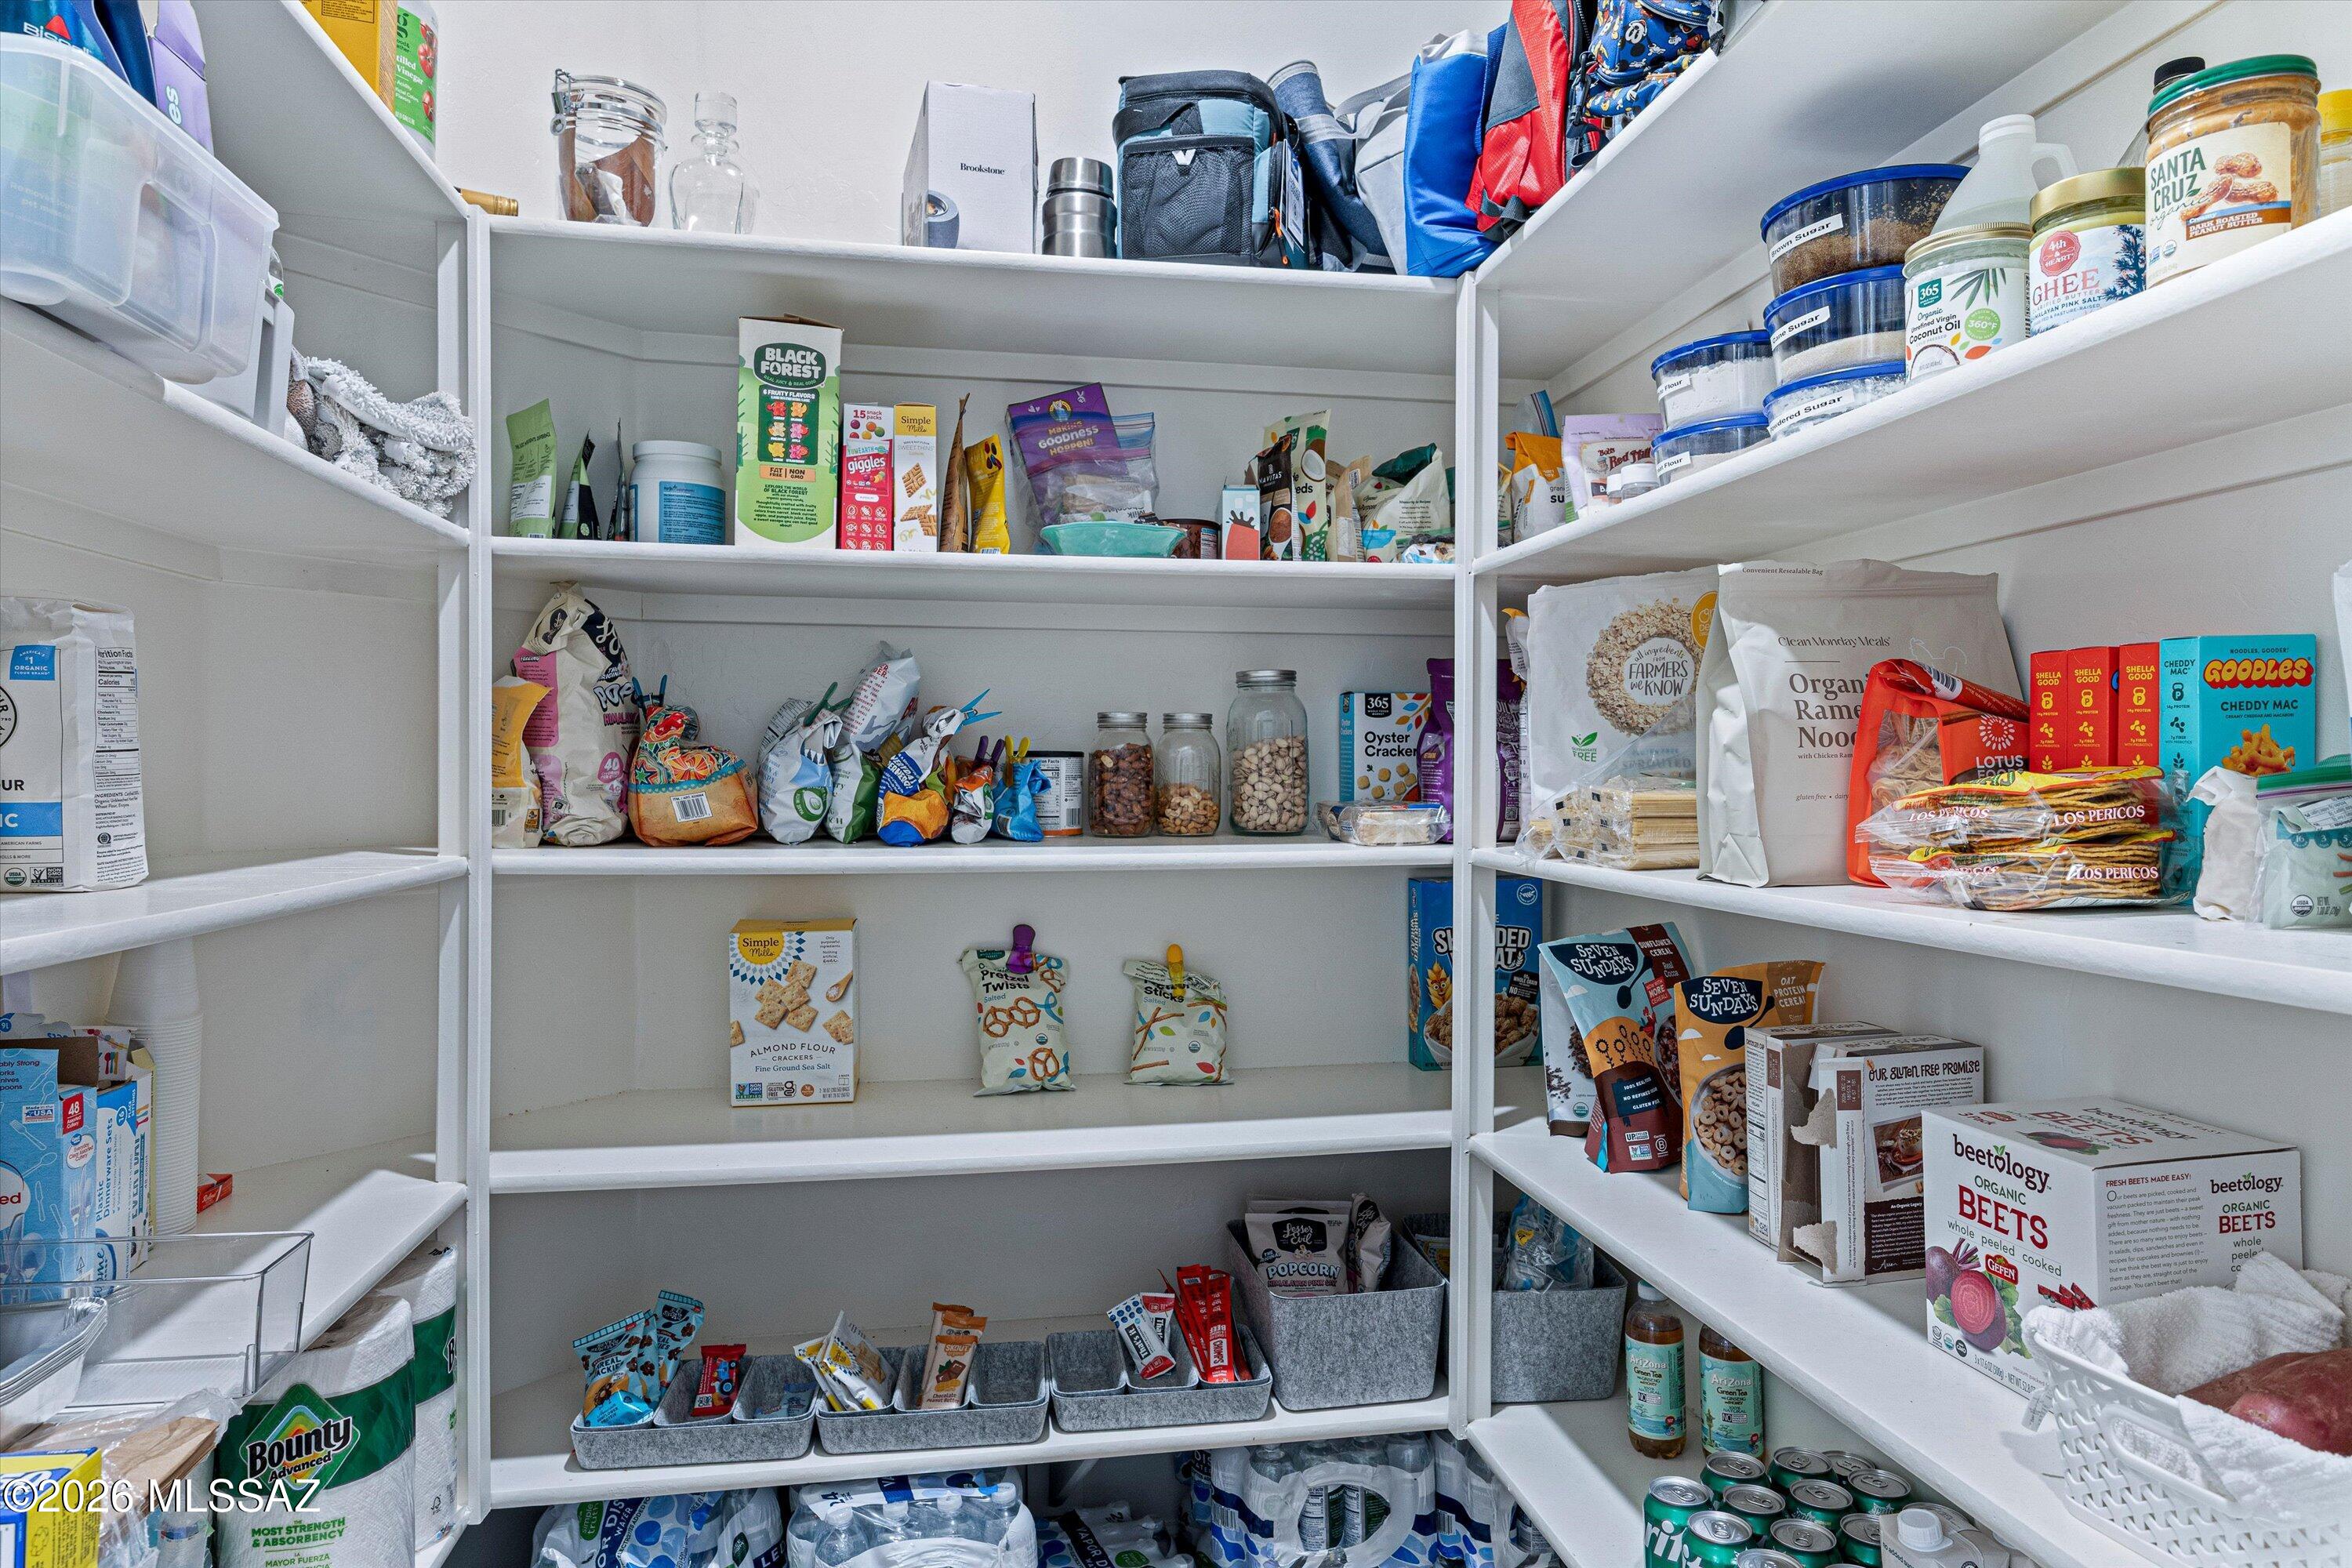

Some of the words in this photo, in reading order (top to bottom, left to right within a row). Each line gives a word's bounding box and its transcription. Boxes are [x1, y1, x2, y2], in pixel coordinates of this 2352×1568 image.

[397, 65, 423, 85] Vinegar
[960, 163, 1005, 175] Brookstone
[2151, 147, 2207, 191] SANTA
[2154, 173, 2199, 212] CRUZ
[2150, 197, 2207, 230] organic
[2189, 221, 2212, 232] DARK
[2216, 212, 2259, 225] ROASTED
[2189, 226, 2225, 238] PEANUT
[2227, 218, 2263, 230] BUTTER
[1771, 239, 1793, 258] Brown
[1795, 221, 1831, 241] Sugar
[2049, 239, 2067, 251] 4th
[2045, 255, 2071, 267] HEART
[1919, 284, 1939, 300] 365
[2032, 268, 2100, 306] GHEE
[2062, 300, 2079, 309] PINK
[1918, 308, 1943, 321] Organic
[1772, 328, 1787, 345] Cane
[1788, 314, 1820, 334] Sugar
[1911, 319, 1935, 332] Unrefined
[1936, 314, 1957, 324] Virgin
[1910, 326, 1943, 344] Coconut
[1945, 320, 1960, 331] Oil
[765, 347, 818, 365] BLACK
[760, 361, 821, 379] FOREST
[1664, 379, 1683, 393] Flour
[1804, 395, 1844, 413] Sugar
[853, 409, 866, 419] 15
[1038, 425, 1099, 449] GOODNESS
[848, 456, 886, 474] giggles
[1609, 452, 1629, 470] Red
[1629, 447, 1652, 463] Mill
[1664, 457, 1683, 470] Flour
[1777, 637, 1812, 648] Clean
[1813, 636, 1857, 648] Monday
[1859, 636, 1889, 648] Meals
[1634, 652, 1643, 662] all
[1644, 644, 1684, 658] ingredients
[1628, 660, 1688, 680] FARMERS
[2164, 659, 2196, 668] CHEDDY
[2203, 657, 2314, 689] GOODLES
[1630, 680, 1643, 691] we
[1644, 678, 1685, 697] KNOW
[1789, 673, 1868, 701] Organi
[1367, 696, 1389, 709] 365
[1795, 699, 1861, 721] Rame
[2220, 700, 2269, 712] CHEDDY
[2273, 699, 2299, 710] MAC
[1364, 731, 1410, 745] Oyster
[1364, 746, 1417, 757] Cracker
[1572, 751, 1597, 762] FREE
[604, 758, 620, 771] 40
[1976, 756, 2024, 768] LOTUS
[2054, 813, 2087, 826] LOS
[2089, 805, 2145, 822] PERICOS
[2077, 867, 2103, 880] LOS
[2104, 866, 2159, 879] PERICOS
[742, 937, 779, 948] Simple
[1638, 938, 1672, 949] SUNFLOWER
[749, 948, 775, 957] Mills
[1576, 945, 1620, 959] SEVEN
[1650, 948, 1673, 956] CEREAL
[1570, 956, 1635, 978] SUNDAYS
[981, 970, 1029, 982] Pretzel
[1780, 976, 1796, 985] OAT
[982, 982, 1030, 994] Twists
[1649, 985, 1665, 997] MORE
[1703, 978, 1748, 995] SEVEN
[1774, 985, 1806, 998] PROTEIN
[984, 993, 1007, 1003] Salted
[1143, 987, 1185, 1003] Sticks
[1143, 996, 1166, 1006] Salted
[1690, 993, 1759, 1016] SUNDAYS
[750, 1043, 797, 1058] ALMOND
[800, 1043, 836, 1054] FLOUR
[16, 1058, 40, 1068] Strong
[1868, 1069, 1887, 1082] OUR
[1921, 1065, 1940, 1076] FREE
[68, 1102, 80, 1116] 48
[1953, 1134, 2050, 1194] beetology
[103, 1141, 112, 1218] Dinnerware
[2151, 1175, 2169, 1184] MADE
[2210, 1177, 2282, 1194] beetology
[1974, 1174, 2027, 1206] ORGANIC
[96, 1180, 104, 1222] Plastic
[2222, 1200, 2270, 1214] ORGANIC
[1958, 1184, 2049, 1250] BEETS
[2219, 1211, 2275, 1234] BEETS
[1283, 1223, 1313, 1238] Lesser
[1290, 1233, 1312, 1244] Evil
[1947, 1219, 1976, 1239] whole
[1980, 1234, 2015, 1257] peeled
[2022, 1253, 2062, 1278] cooked
[2233, 1236, 2262, 1247] whole
[1266, 1261, 1341, 1279] POPCORN
[1986, 1258, 2016, 1280] GEFEN
[1630, 1354, 1668, 1370] AriZona
[1634, 1367, 1651, 1377] Green
[1652, 1370, 1662, 1379] Tea
[1711, 1374, 1752, 1386] AriZona
[1717, 1387, 1736, 1396] Green
[246, 1417, 353, 1479] Bounty
[269, 1450, 332, 1483] Advanced
[252, 1526, 284, 1537] MOST
[285, 1517, 345, 1536] STRENGTH
[252, 1538, 260, 1548] &
[263, 1528, 345, 1547] ABSORBENCY
[265, 1558, 296, 1567] MAYOR
[298, 1553, 330, 1564] FUERZA
